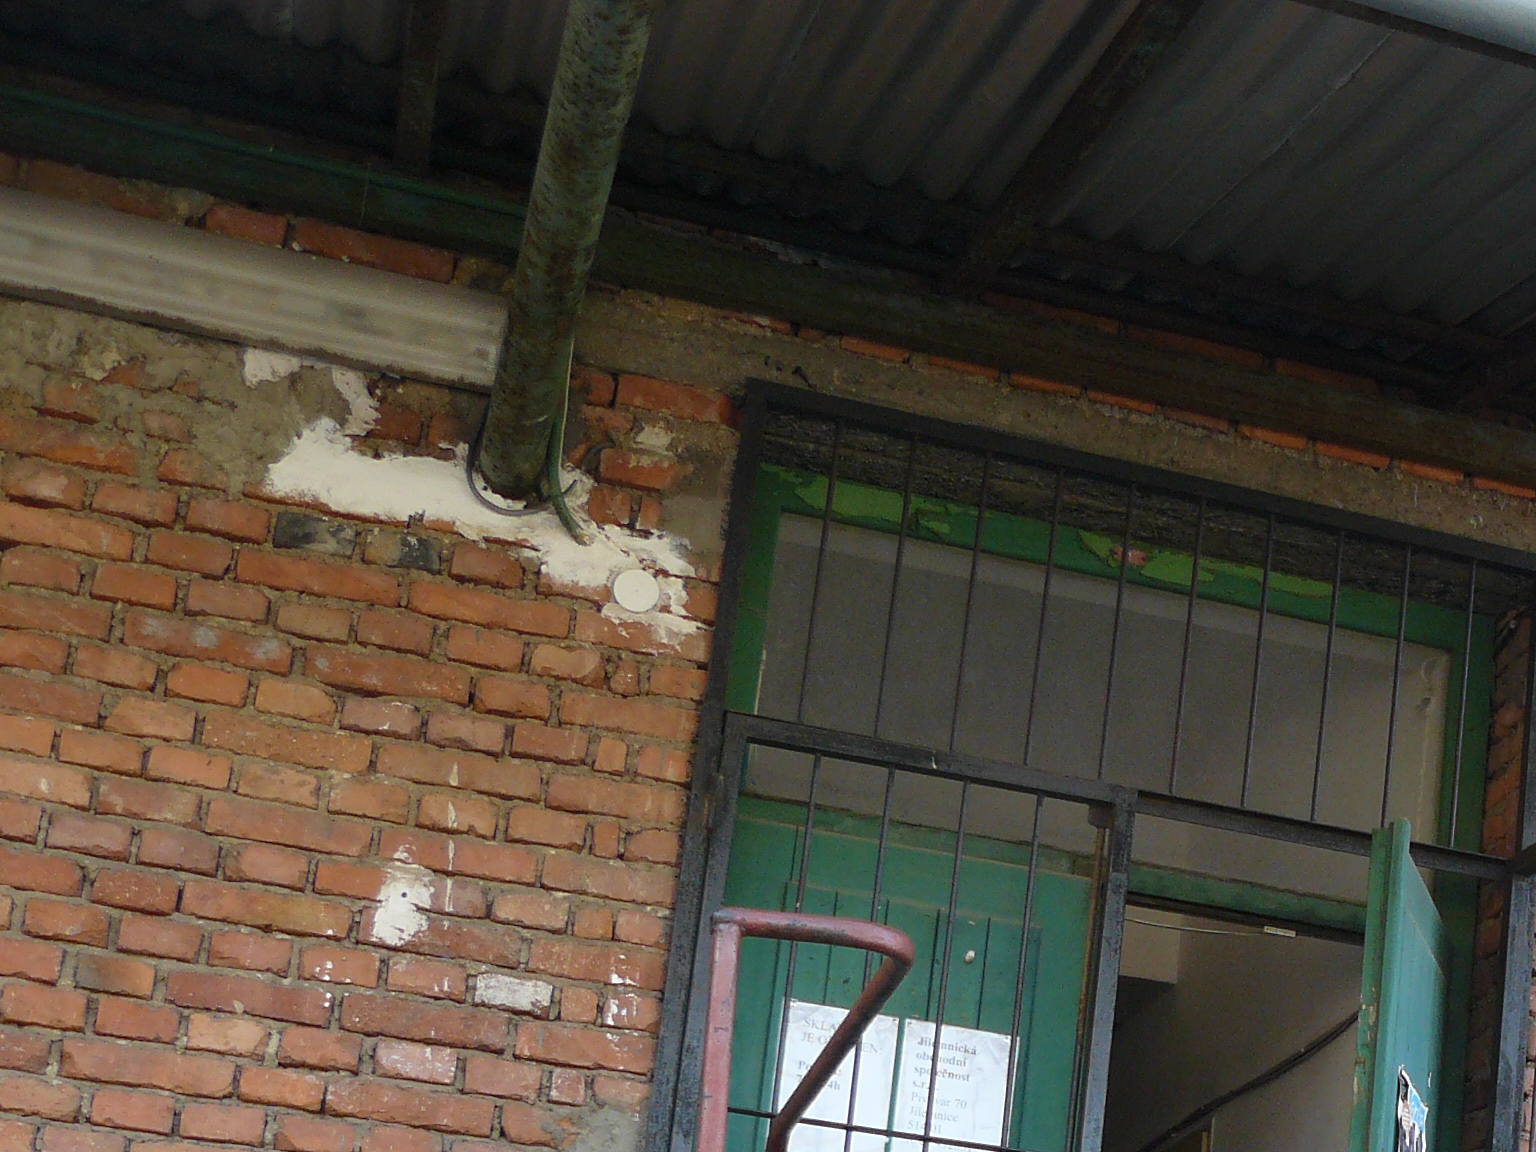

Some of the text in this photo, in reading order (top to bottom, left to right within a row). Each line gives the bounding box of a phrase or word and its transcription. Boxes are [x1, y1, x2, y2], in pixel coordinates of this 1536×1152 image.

[800, 1031, 815, 1043] JE
[916, 1036, 977, 1056] Jilmnická
[914, 1066, 971, 1083] spoečnost
[910, 1091, 952, 1107] Pivvar
